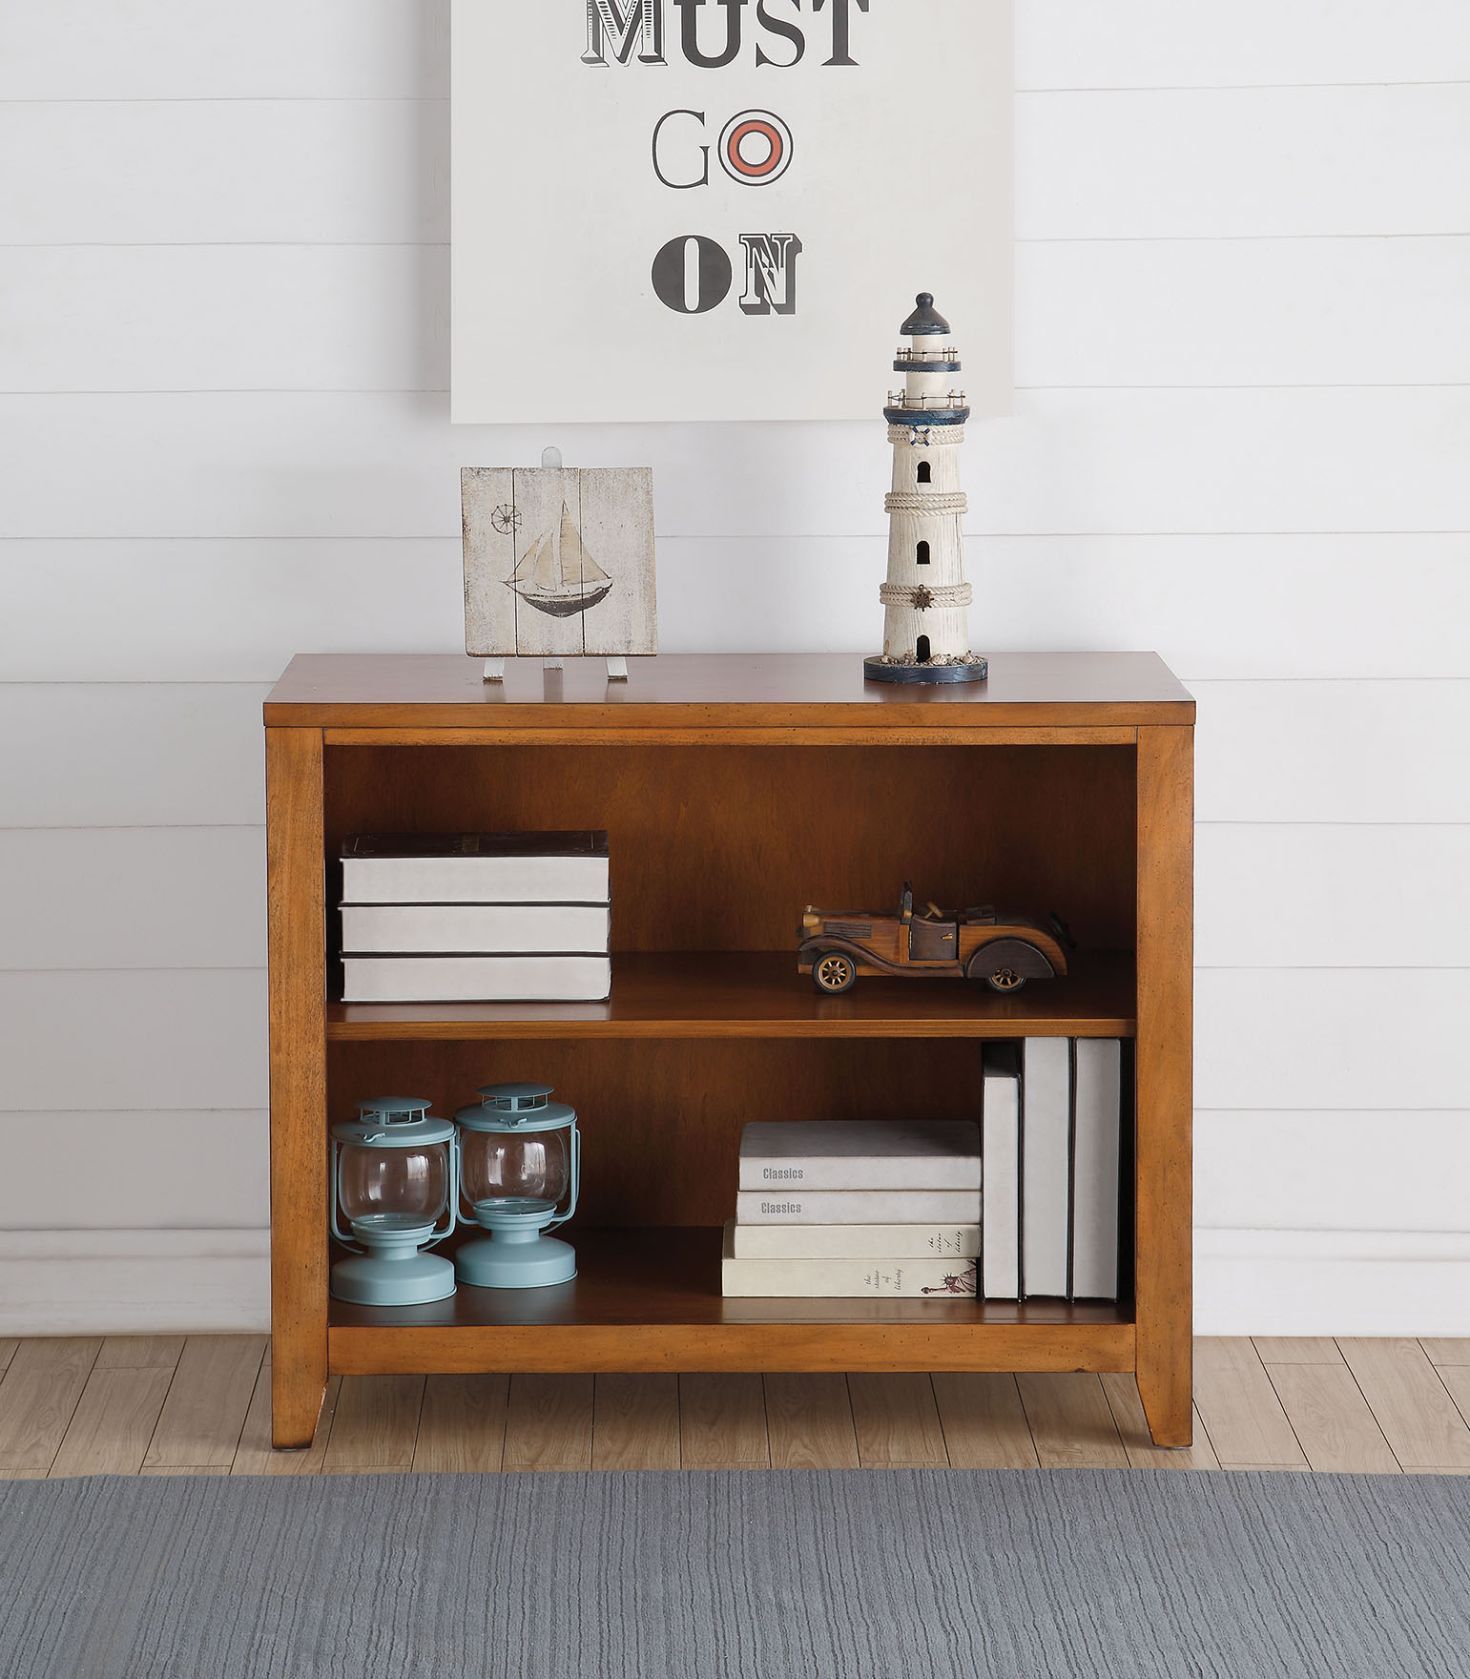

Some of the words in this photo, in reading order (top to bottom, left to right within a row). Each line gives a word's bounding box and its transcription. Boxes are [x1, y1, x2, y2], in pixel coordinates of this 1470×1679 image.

[580, 0, 869, 69] MUST
[652, 109, 794, 189] GO
[651, 232, 803, 316] ON
[761, 1202, 802, 1214] Classics
[763, 1168, 804, 1180] Classics
